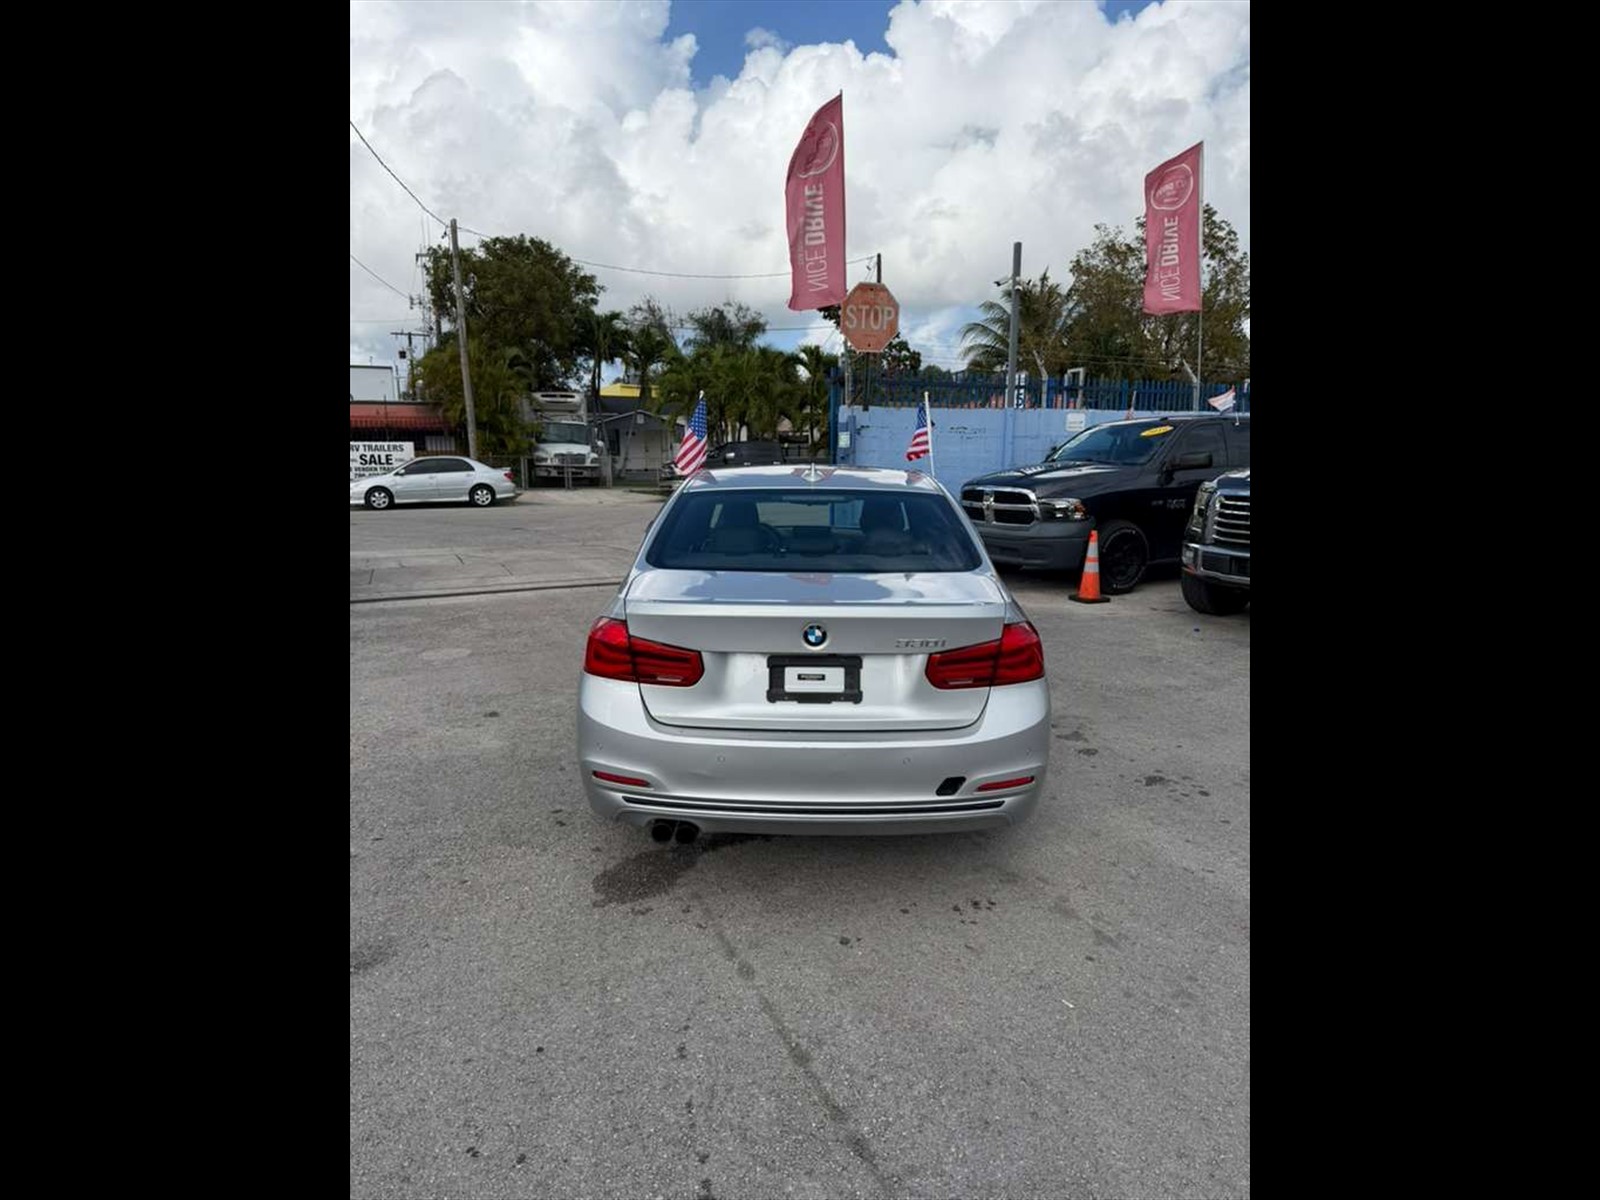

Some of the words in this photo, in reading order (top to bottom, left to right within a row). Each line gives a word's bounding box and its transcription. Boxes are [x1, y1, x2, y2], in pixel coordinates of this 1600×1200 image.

[847, 304, 895, 330] STOP
[362, 444, 404, 452] TRAILERS
[359, 453, 393, 466] SALE
